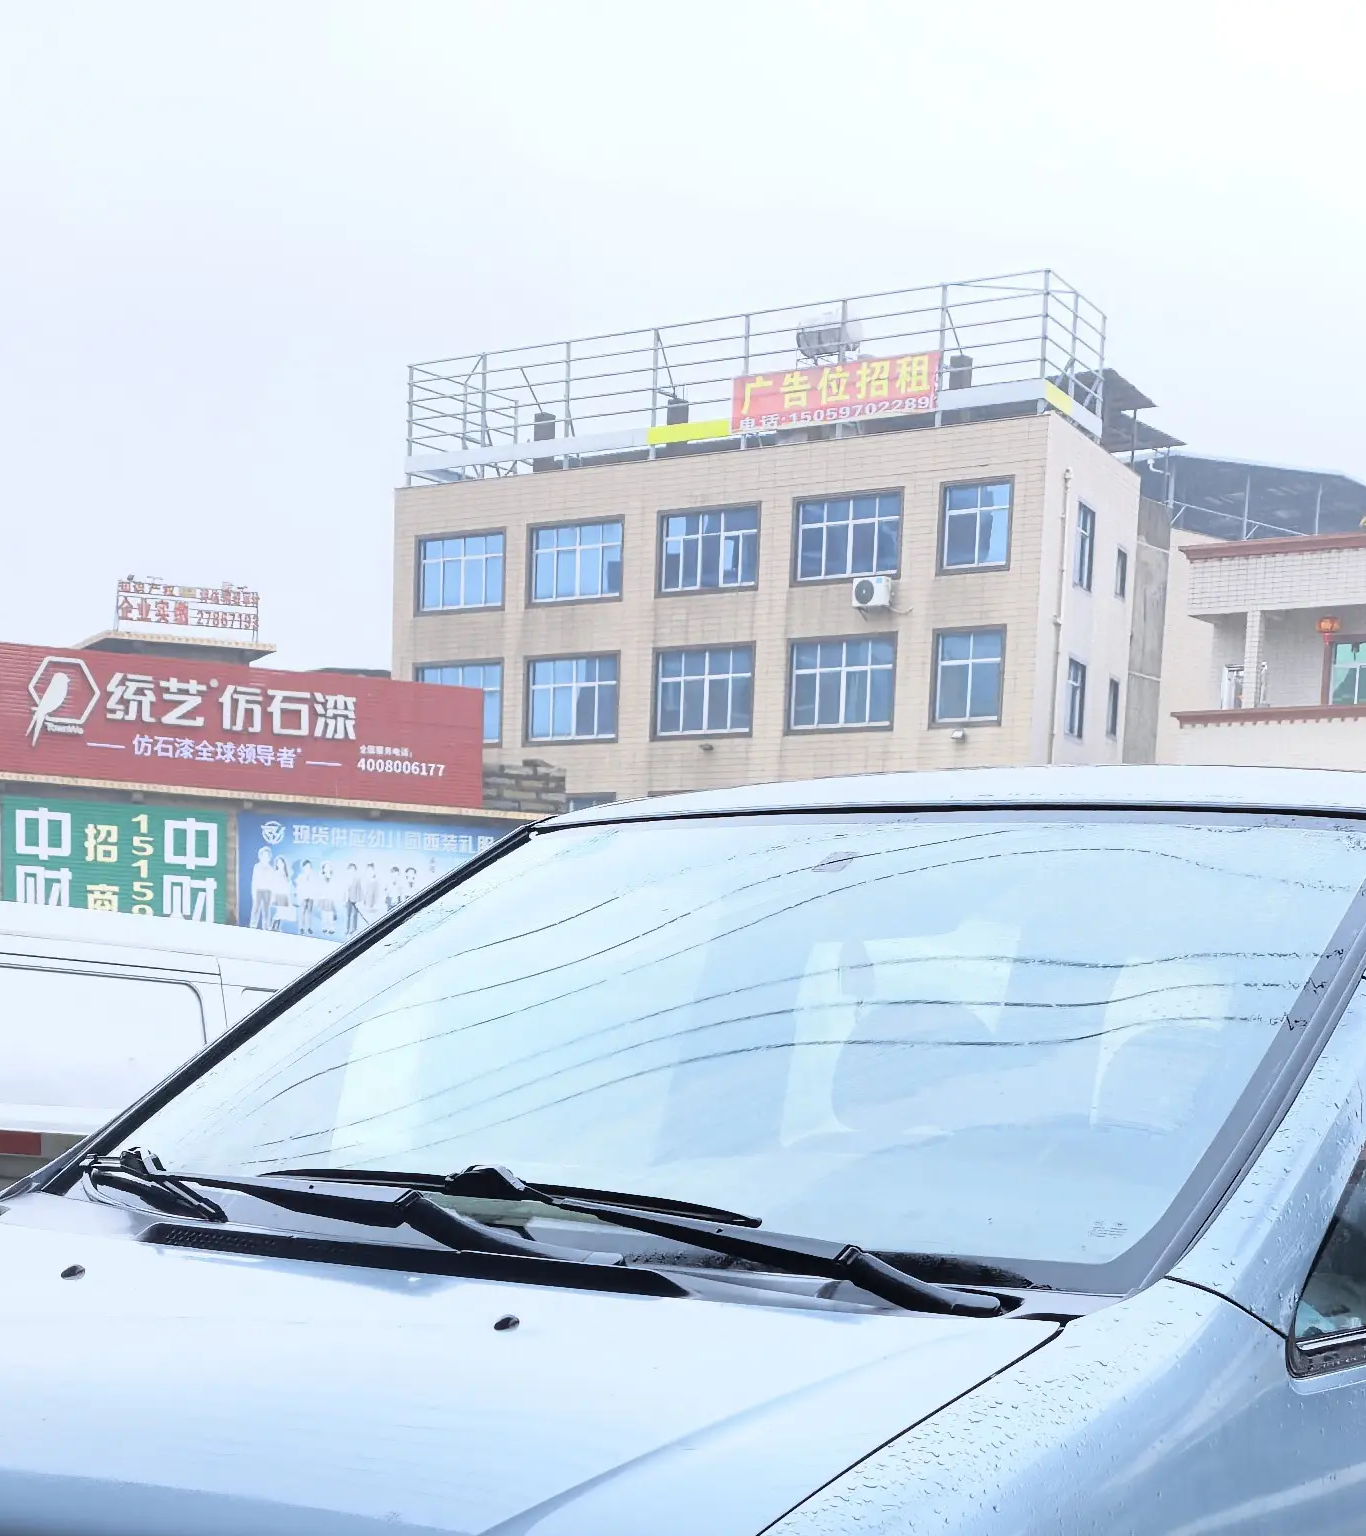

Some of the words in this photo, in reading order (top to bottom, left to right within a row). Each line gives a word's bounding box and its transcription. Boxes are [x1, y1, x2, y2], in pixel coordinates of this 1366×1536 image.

[742, 354, 931, 415] 广告位招租
[106, 672, 207, 727] 统艺
[218, 684, 357, 740] 仿石漆
[132, 734, 297, 769] 仿石漆全球领导者
[357, 758, 446, 777] 4008006177
[15, 807, 72, 906] 中财
[84, 823, 119, 912] 招商
[163, 817, 218, 922] 中财
